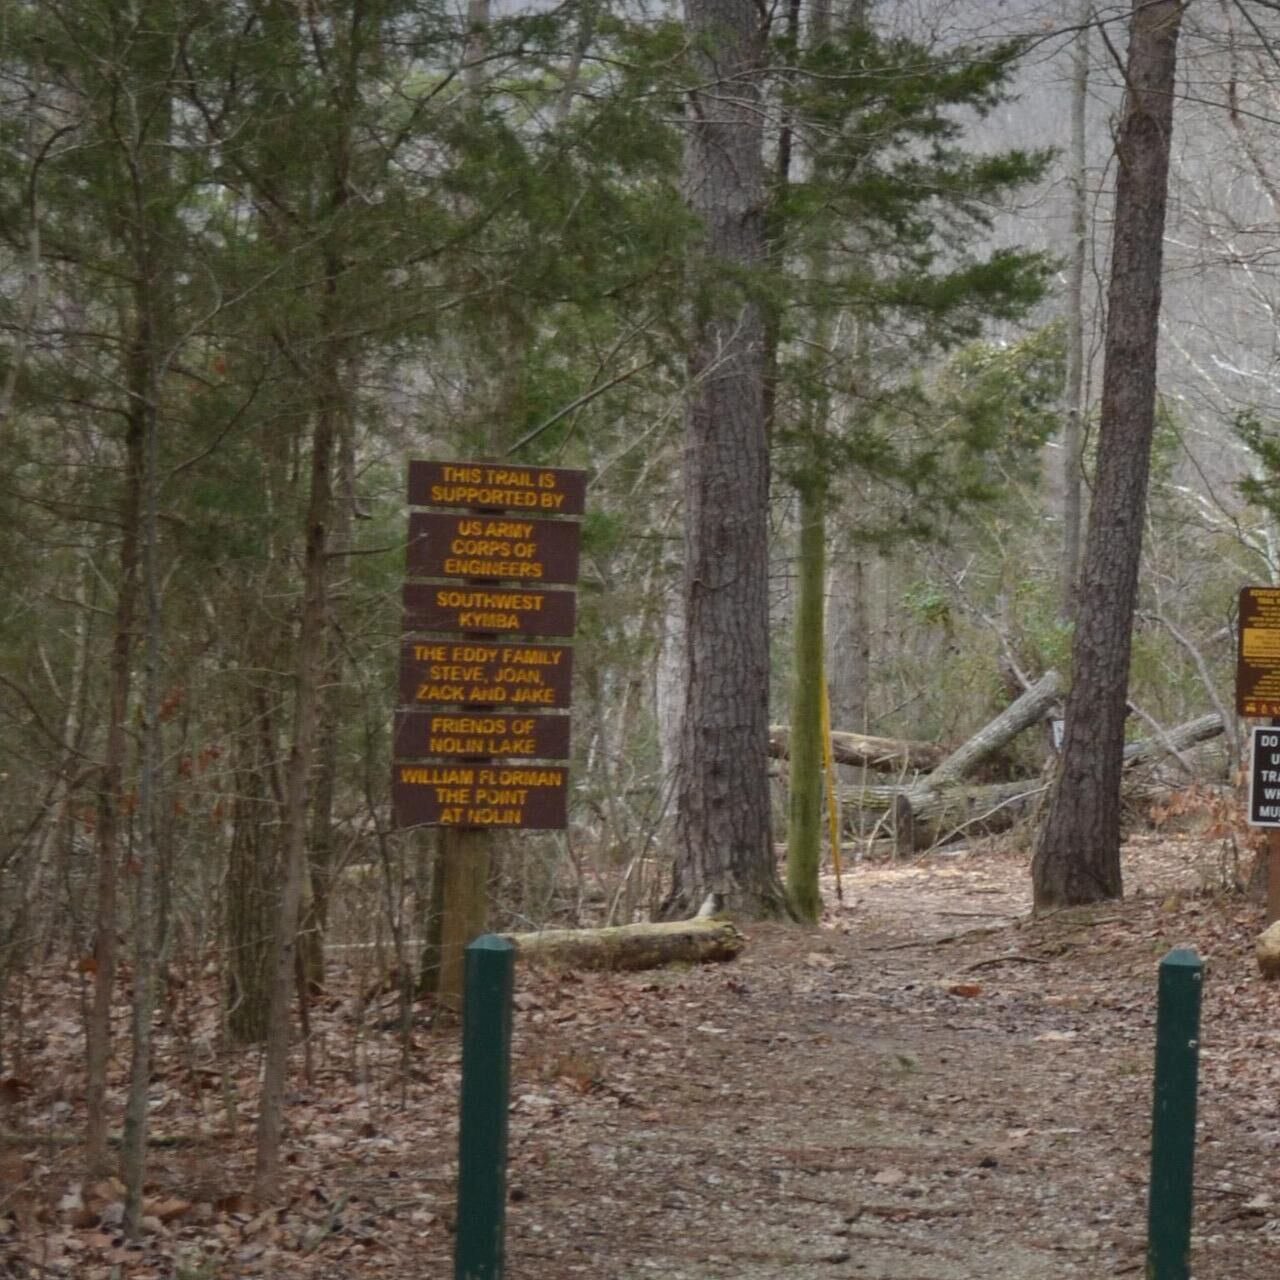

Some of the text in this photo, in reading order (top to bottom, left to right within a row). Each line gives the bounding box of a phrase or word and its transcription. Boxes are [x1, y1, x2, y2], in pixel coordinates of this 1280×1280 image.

[441, 466, 556, 488] THIS TRAIL IS
[431, 486, 564, 508] SUPPORTED BY
[459, 521, 533, 538] US ARMY
[452, 539, 537, 558] CORPS OF
[444, 558, 543, 577] ENGINEERS
[436, 591, 544, 610] SOUTHWEST
[459, 612, 520, 628] KYMBA
[415, 646, 562, 665] THE EDDY FAMILY
[430, 666, 545, 686] STEVE, JOAN,
[417, 684, 555, 703] ZACK AND JAKE
[431, 718, 536, 735] FRIENDS OF
[430, 738, 536, 754] NOLIN LAKE
[1261, 735, 1278, 748] DO
[401, 769, 562, 786] WILLIAM FLORMAN
[436, 788, 528, 805] THE POINT
[439, 808, 521, 824] AT NOLIN
